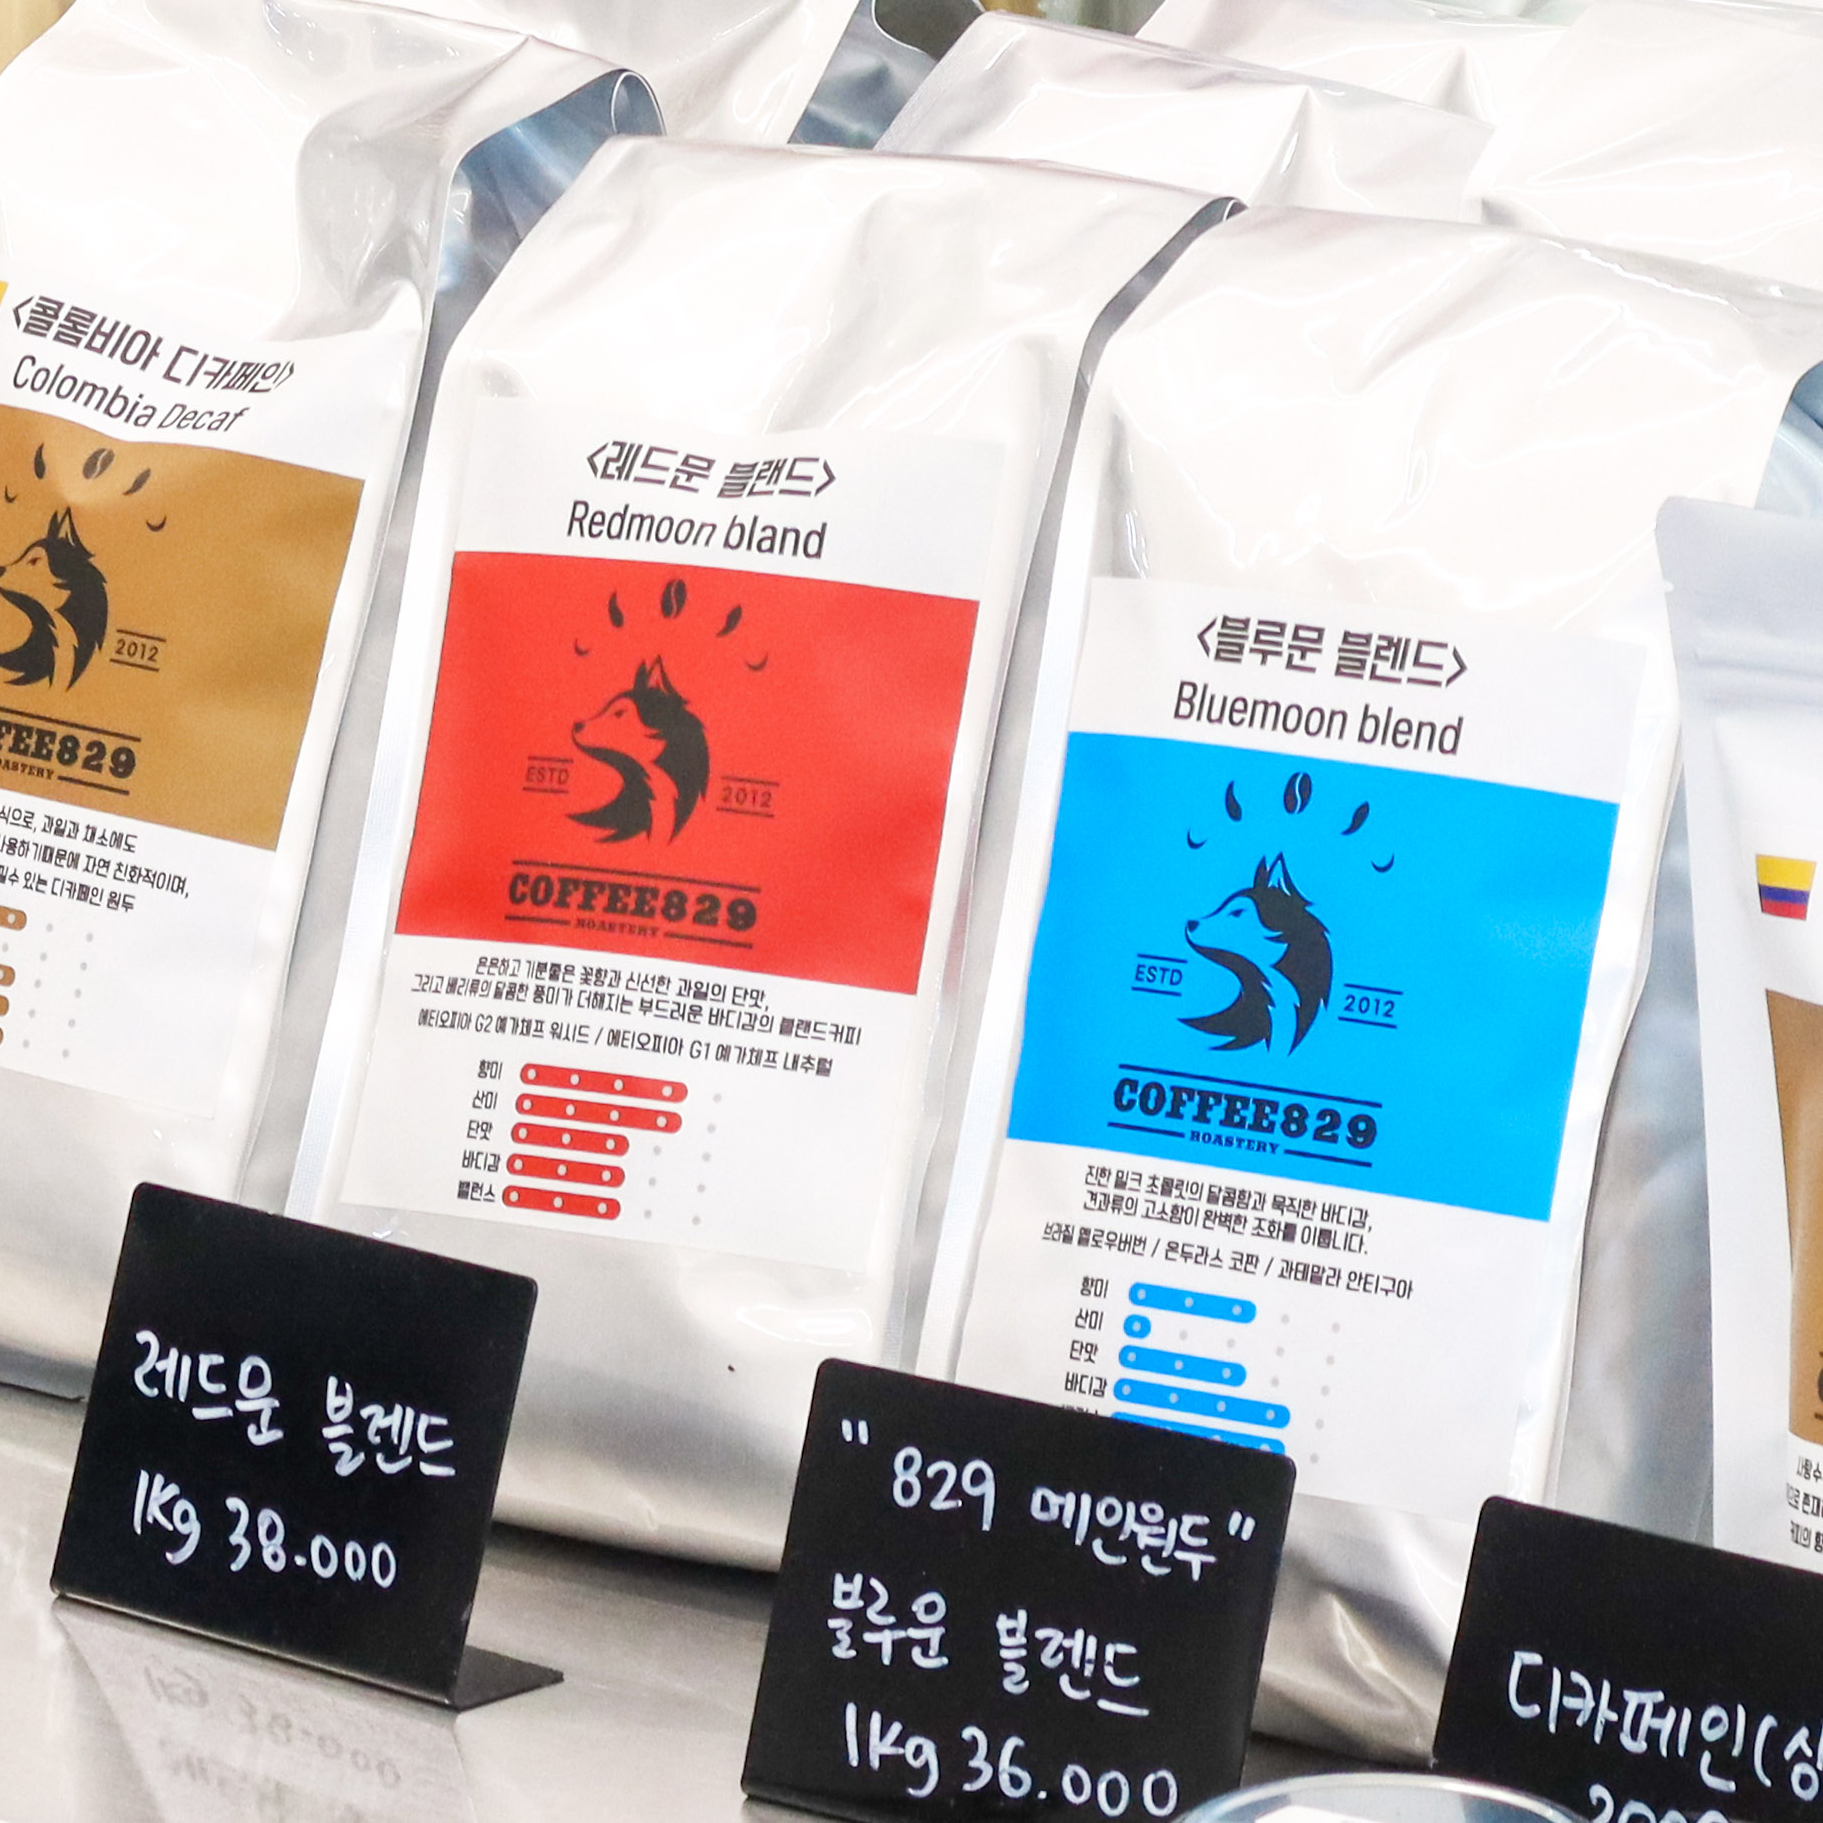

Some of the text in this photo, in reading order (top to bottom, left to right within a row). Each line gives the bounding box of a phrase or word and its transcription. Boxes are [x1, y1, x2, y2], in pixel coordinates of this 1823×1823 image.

[12, 355, 250, 432] Colombia Decaf
[567, 499, 827, 559] Redmoon bland
[115, 639, 160, 662] 2012
[1173, 679, 1464, 756] Bluemoon blend
[527, 766, 570, 786] ESTD
[721, 786, 773, 809] 2012
[41, 814, 79, 839] 과일과
[83, 855, 111, 878] 자연
[22, 870, 48, 894] 있는
[106, 891, 136, 912] 원두
[508, 872, 757, 932] COFFEE829
[475, 956, 521, 977] 은은하고
[626, 971, 672, 996] 신선한
[676, 977, 727, 1003] 과일의
[1135, 964, 1183, 986] ESTD
[411, 974, 445, 994] 그리고
[532, 984, 574, 1007] 풍미가
[577, 989, 634, 1016] 더해지는
[638, 996, 704, 1025] 부드러운
[708, 1007, 775, 1034] 바디감의
[1343, 994, 1396, 1018] 2012
[418, 1007, 472, 1030] 에티오피아
[475, 1013, 494, 1034] G2
[549, 1021, 591, 1044] 워시드
[606, 1028, 684, 1057] 에티오피아
[689, 1039, 711, 1062] G1
[477, 1059, 503, 1080] 향미
[472, 1090, 498, 1110] 산미
[1113, 1077, 1377, 1149] COFFEE829
[466, 1119, 493, 1141] 단맛
[1189, 1130, 1280, 1154] ROASTERY
[461, 1149, 501, 1173] 바디감
[1085, 1164, 1112, 1188] 진한
[457, 1180, 496, 1203] 밸런스
[1083, 1190, 1138, 1216] 견과류의
[1141, 1199, 1200, 1227] 고소함이
[1202, 1209, 1248, 1236] 완벽한
[1164, 1240, 1224, 1269] 온두라스
[1277, 1258, 1342, 1288] 과테말라
[1346, 1270, 1414, 1300] 안티구아
[1080, 1275, 1109, 1299] 향미
[1074, 1307, 1104, 1331] 산미
[1069, 1339, 1099, 1364] 단맛
[1064, 1371, 1108, 1398] 바디감
